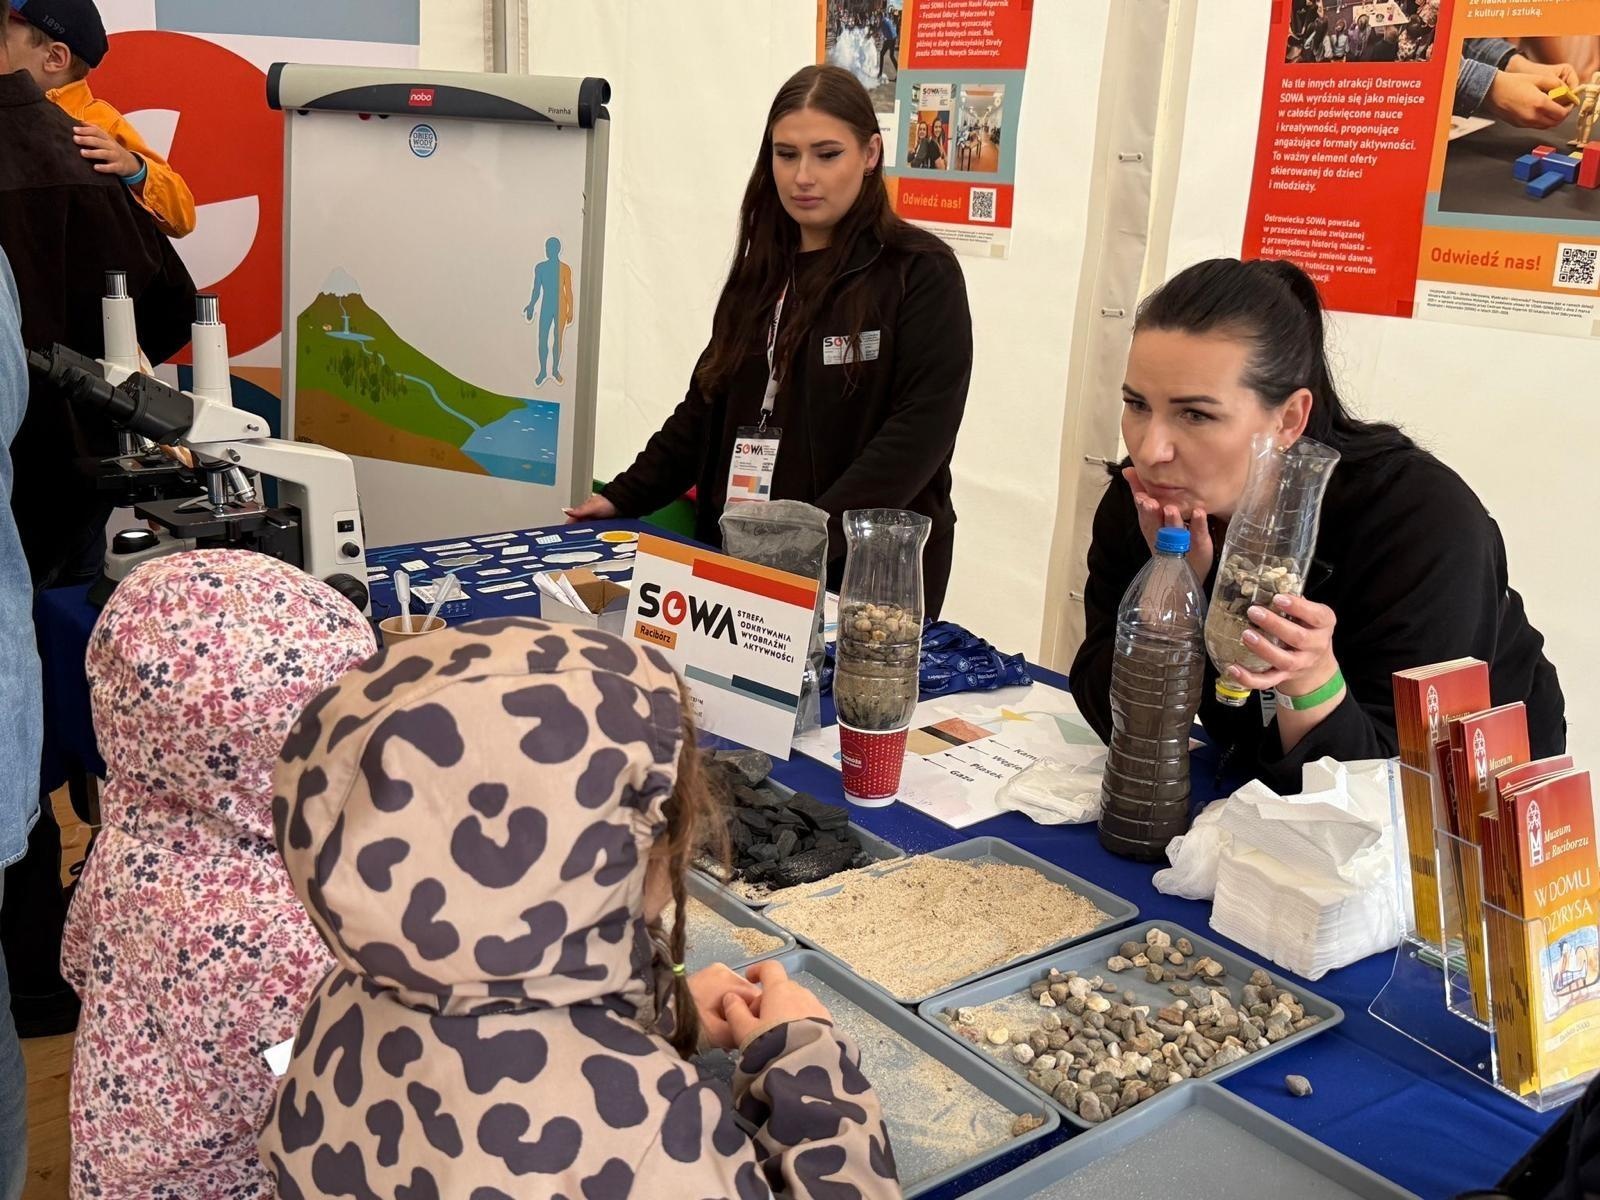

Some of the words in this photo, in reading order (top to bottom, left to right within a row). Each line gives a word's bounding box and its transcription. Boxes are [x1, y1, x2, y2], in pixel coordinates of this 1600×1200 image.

[983, 0, 1008, 8] Kopernik
[960, 10, 987, 18] Wydarzenie
[1475, 9, 1504, 18] kulturą
[1512, 8, 1543, 17] sztuką.
[43, 15, 65, 34] 1899
[985, 39, 1002, 47] Strefy
[1282, 79, 1292, 88] Na
[1295, 78, 1305, 88] tle
[1308, 78, 1334, 90] innych
[1338, 78, 1372, 90] atrakcji
[1375, 78, 1421, 89] Ostrowca
[410, 92, 432, 101] nobo
[1280, 93, 1303, 103] SOWA
[1306, 93, 1345, 105] wyróżnia
[1348, 93, 1361, 105] się
[1364, 93, 1384, 105] jako
[1387, 94, 1425, 105] miejsce
[1287, 108, 1316, 117] całości
[1318, 108, 1371, 120] poświęcone
[1374, 110, 1403, 119] nauce
[1276, 123, 1279, 132] i
[1281, 122, 1338, 134] kreatywności,
[1341, 125, 1399, 136] proponujące
[1274, 137, 1320, 148] angażujące
[1323, 138, 1358, 150] formaty
[1360, 139, 1416, 151] aktywności.
[1273, 151, 1280, 160] To
[1284, 151, 1309, 163] ważny
[1312, 153, 1347, 163] element
[1350, 154, 1377, 166] oferty
[1271, 166, 1320, 179] skierowanej
[1323, 168, 1333, 177] do
[1336, 168, 1362, 178] dzieci
[1269, 179, 1272, 188] i
[1273, 180, 1316, 193] młodzieży.
[902, 193, 938, 207] Odwiedź
[941, 197, 961, 208] nas!
[1265, 214, 1304, 224] Ostrowiecka
[1306, 216, 1326, 225] SOWA
[1328, 218, 1360, 228] powstała
[1270, 226, 1307, 235] przestrzeni
[1309, 228, 1327, 237] silnie
[1329, 230, 1364, 241] związanej
[1267, 238, 1310, 247] przemysłową
[1312, 240, 1338, 250] historią
[1340, 242, 1364, 251] miasta
[1275, 248, 1317, 258] symbolicznie
[1319, 252, 1346, 261] zmienia
[1348, 253, 1373, 264] dawną
[1431, 247, 1499, 268] Odwiedź
[1504, 255, 1542, 271] nas!
[1305, 262, 1334, 272] hutniczą
[1344, 265, 1376, 274] centrum
[735, 444, 764, 455] SOWA
[638, 582, 738, 646] SOWA
[737, 610, 765, 624] STREFA
[640, 626, 671, 644] Racibórz
[740, 621, 791, 643] ODKRYWANIA
[741, 630, 786, 651] WYOBRAŹNI
[743, 642, 794, 664] AKTYWNOŚCI
[1489, 754, 1512, 771] Muzeum
[950, 770, 974, 782] Gaza
[970, 763, 1003, 779] Piasek
[1544, 824, 1571, 844] Muzeum
[1552, 836, 1589, 858] Raciborzu
[1534, 886, 1548, 908] W
[1549, 867, 1590, 902] DOMU
[1543, 898, 1593, 934] OZYRYSA
